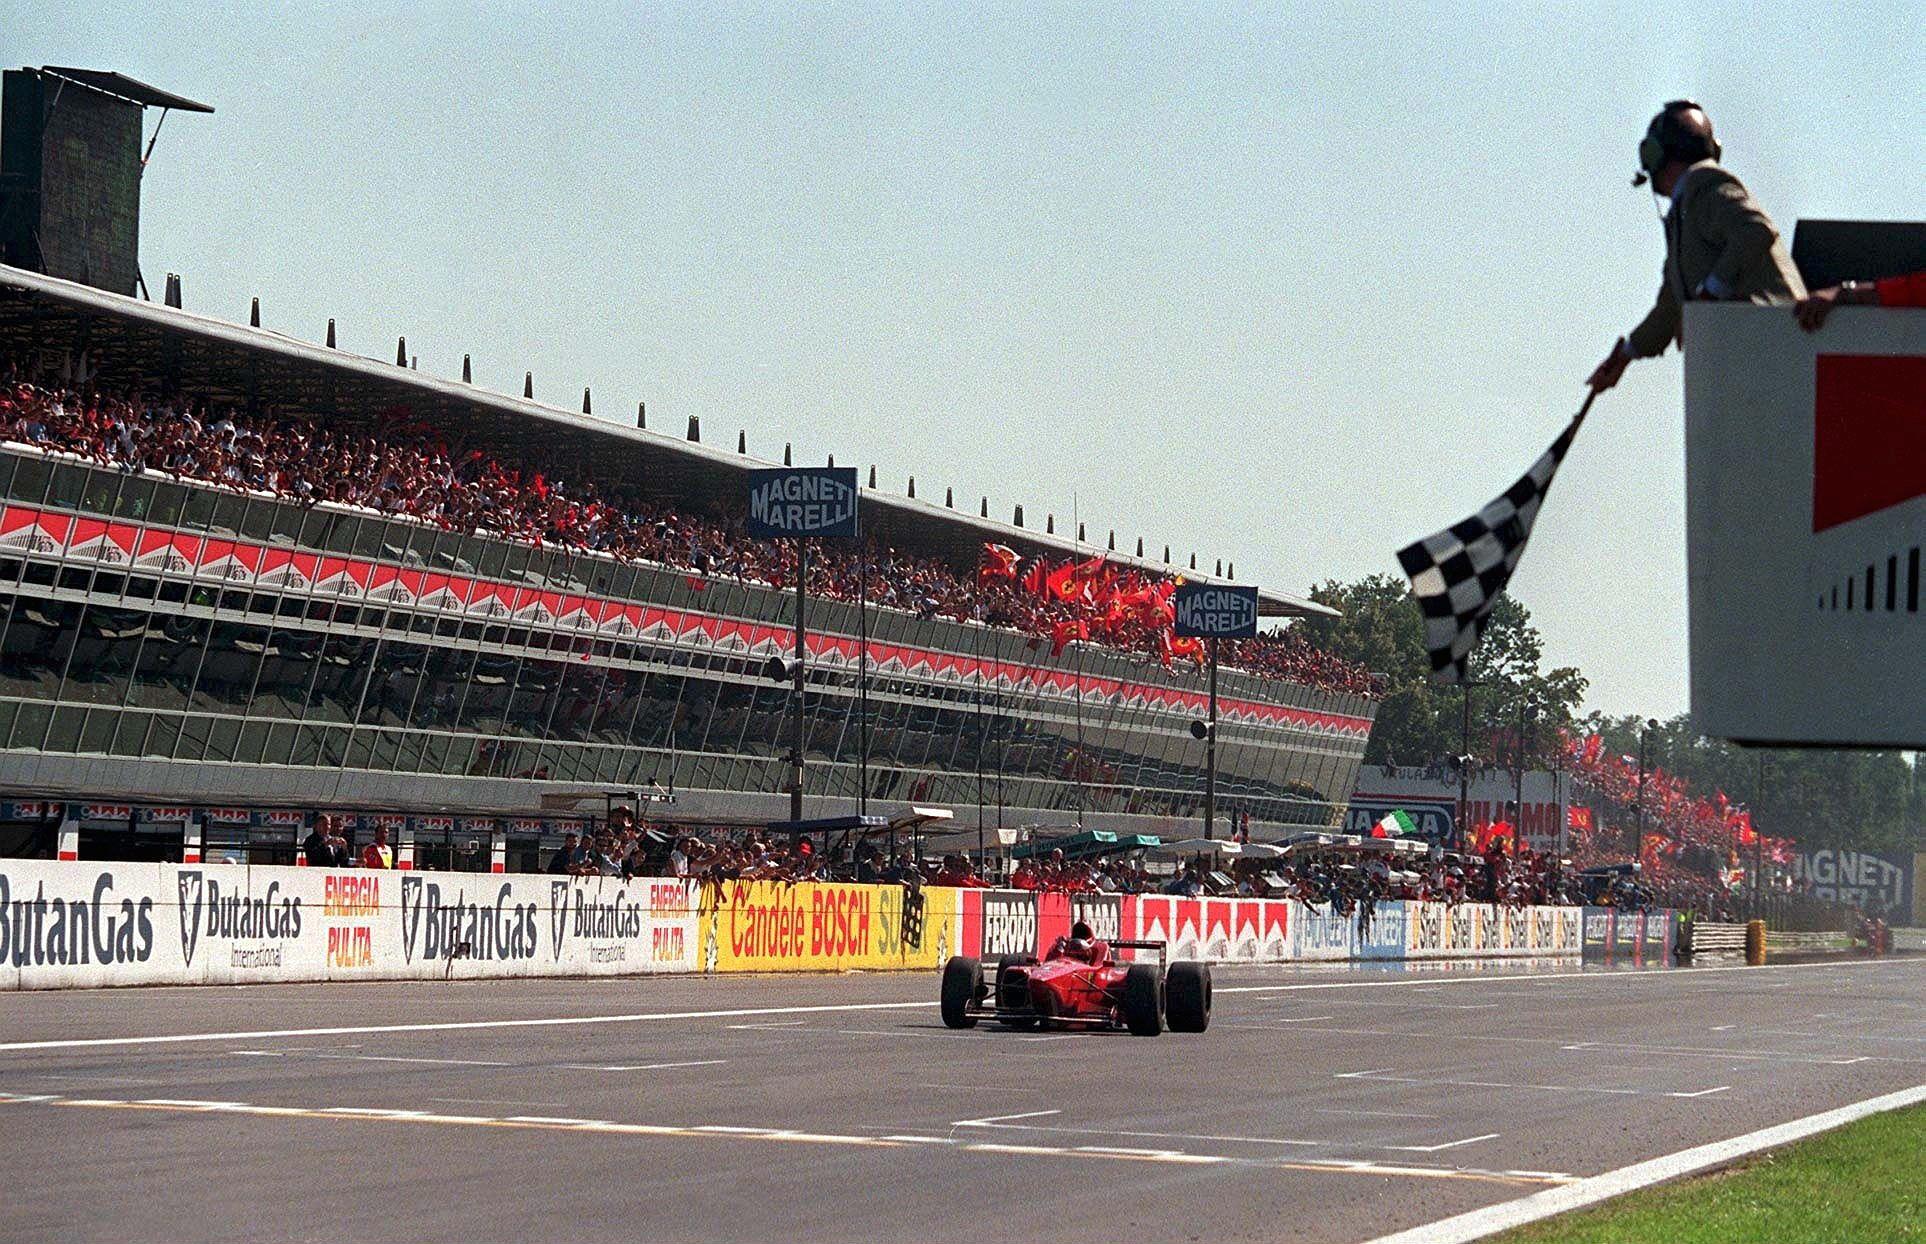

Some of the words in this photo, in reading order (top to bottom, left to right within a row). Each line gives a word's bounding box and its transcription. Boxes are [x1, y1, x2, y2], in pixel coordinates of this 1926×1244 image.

[751, 475, 854, 506] MAGNETI
[751, 500, 854, 530] MARELLI
[1177, 591, 1255, 614] MAGNETI
[1177, 610, 1255, 632] MARELLI
[206, 880, 301, 939] ButanGas
[324, 875, 379, 916] ENERGIA
[574, 889, 640, 938] ButanGas
[650, 885, 690, 918] ENERGIA
[423, 882, 537, 960] ButanGas
[731, 885, 804, 957] Candele
[812, 889, 870, 956] BOSCH
[985, 901, 1036, 954] FERODO
[327, 927, 372, 967] PULITA
[652, 927, 684, 960] PULITA
